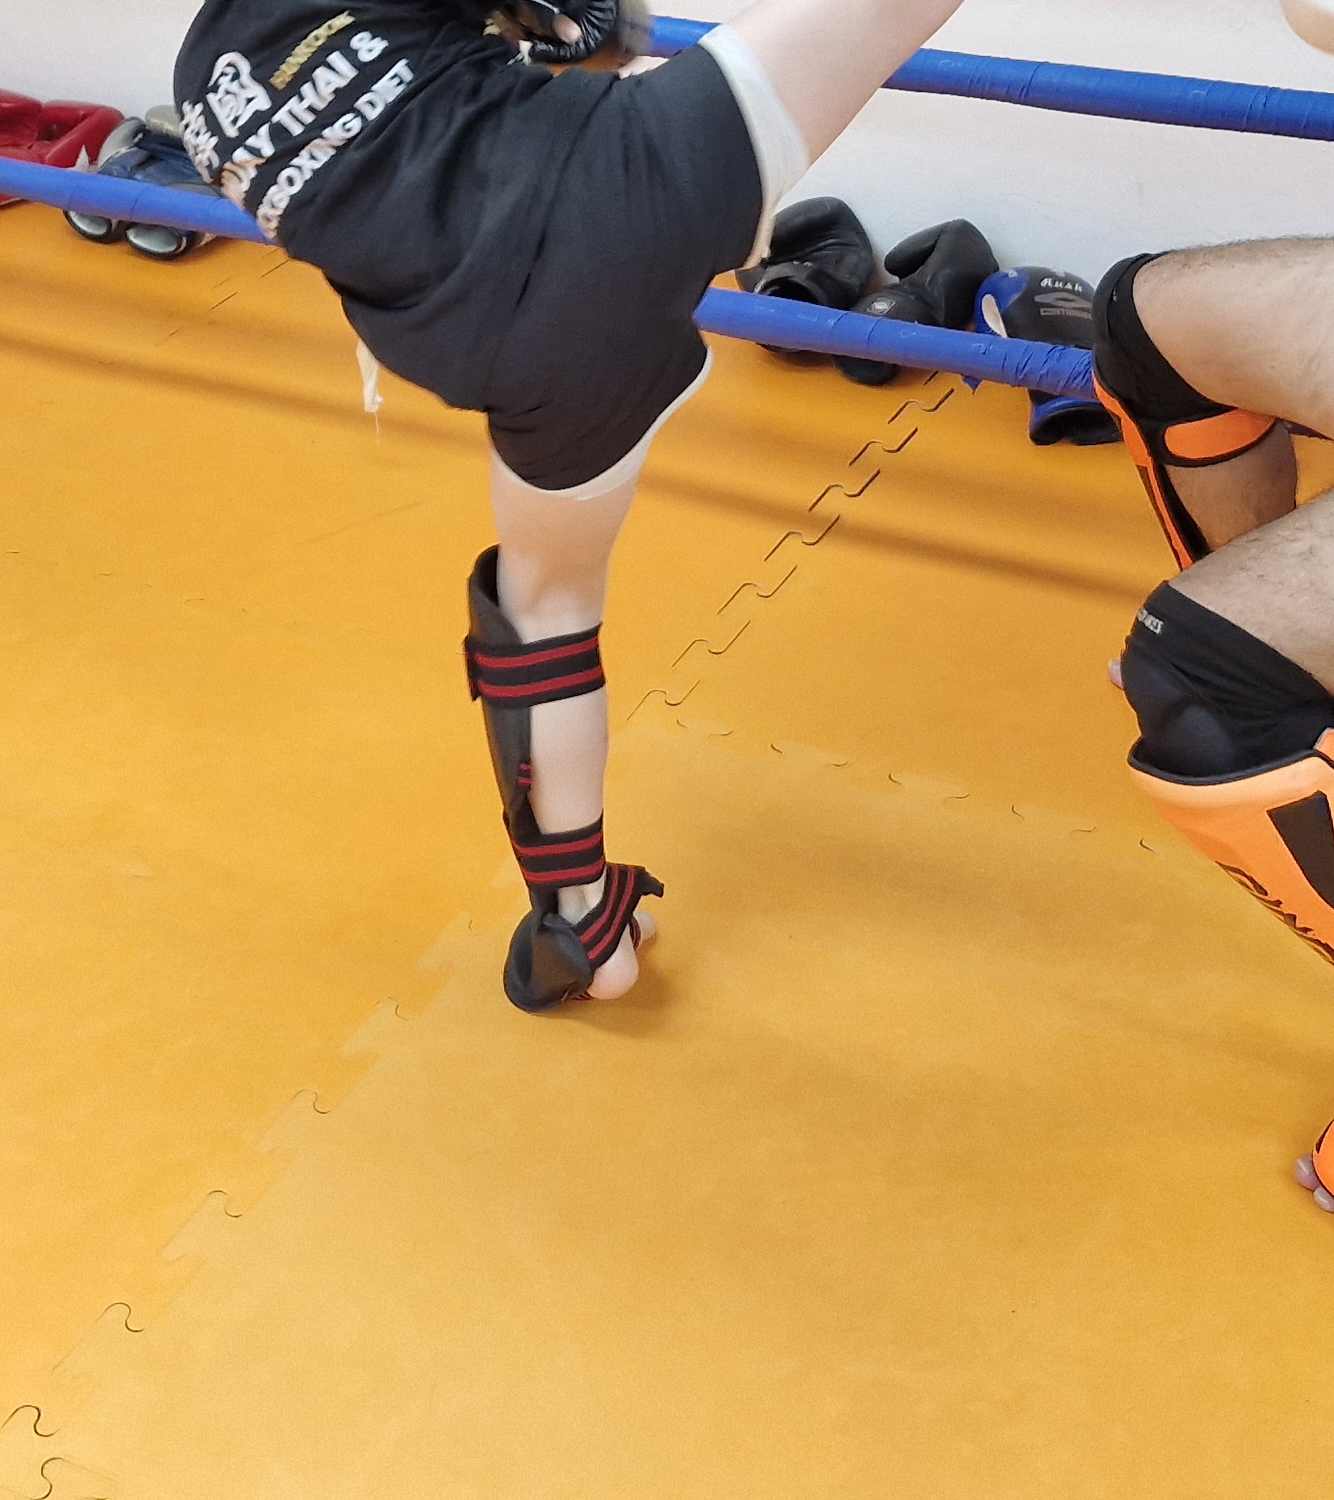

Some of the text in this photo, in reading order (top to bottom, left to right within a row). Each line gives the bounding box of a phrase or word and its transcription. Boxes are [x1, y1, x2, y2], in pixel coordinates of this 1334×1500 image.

[271, 50, 359, 137] THAI
[349, 31, 390, 63] &
[353, 58, 415, 121] DIET
